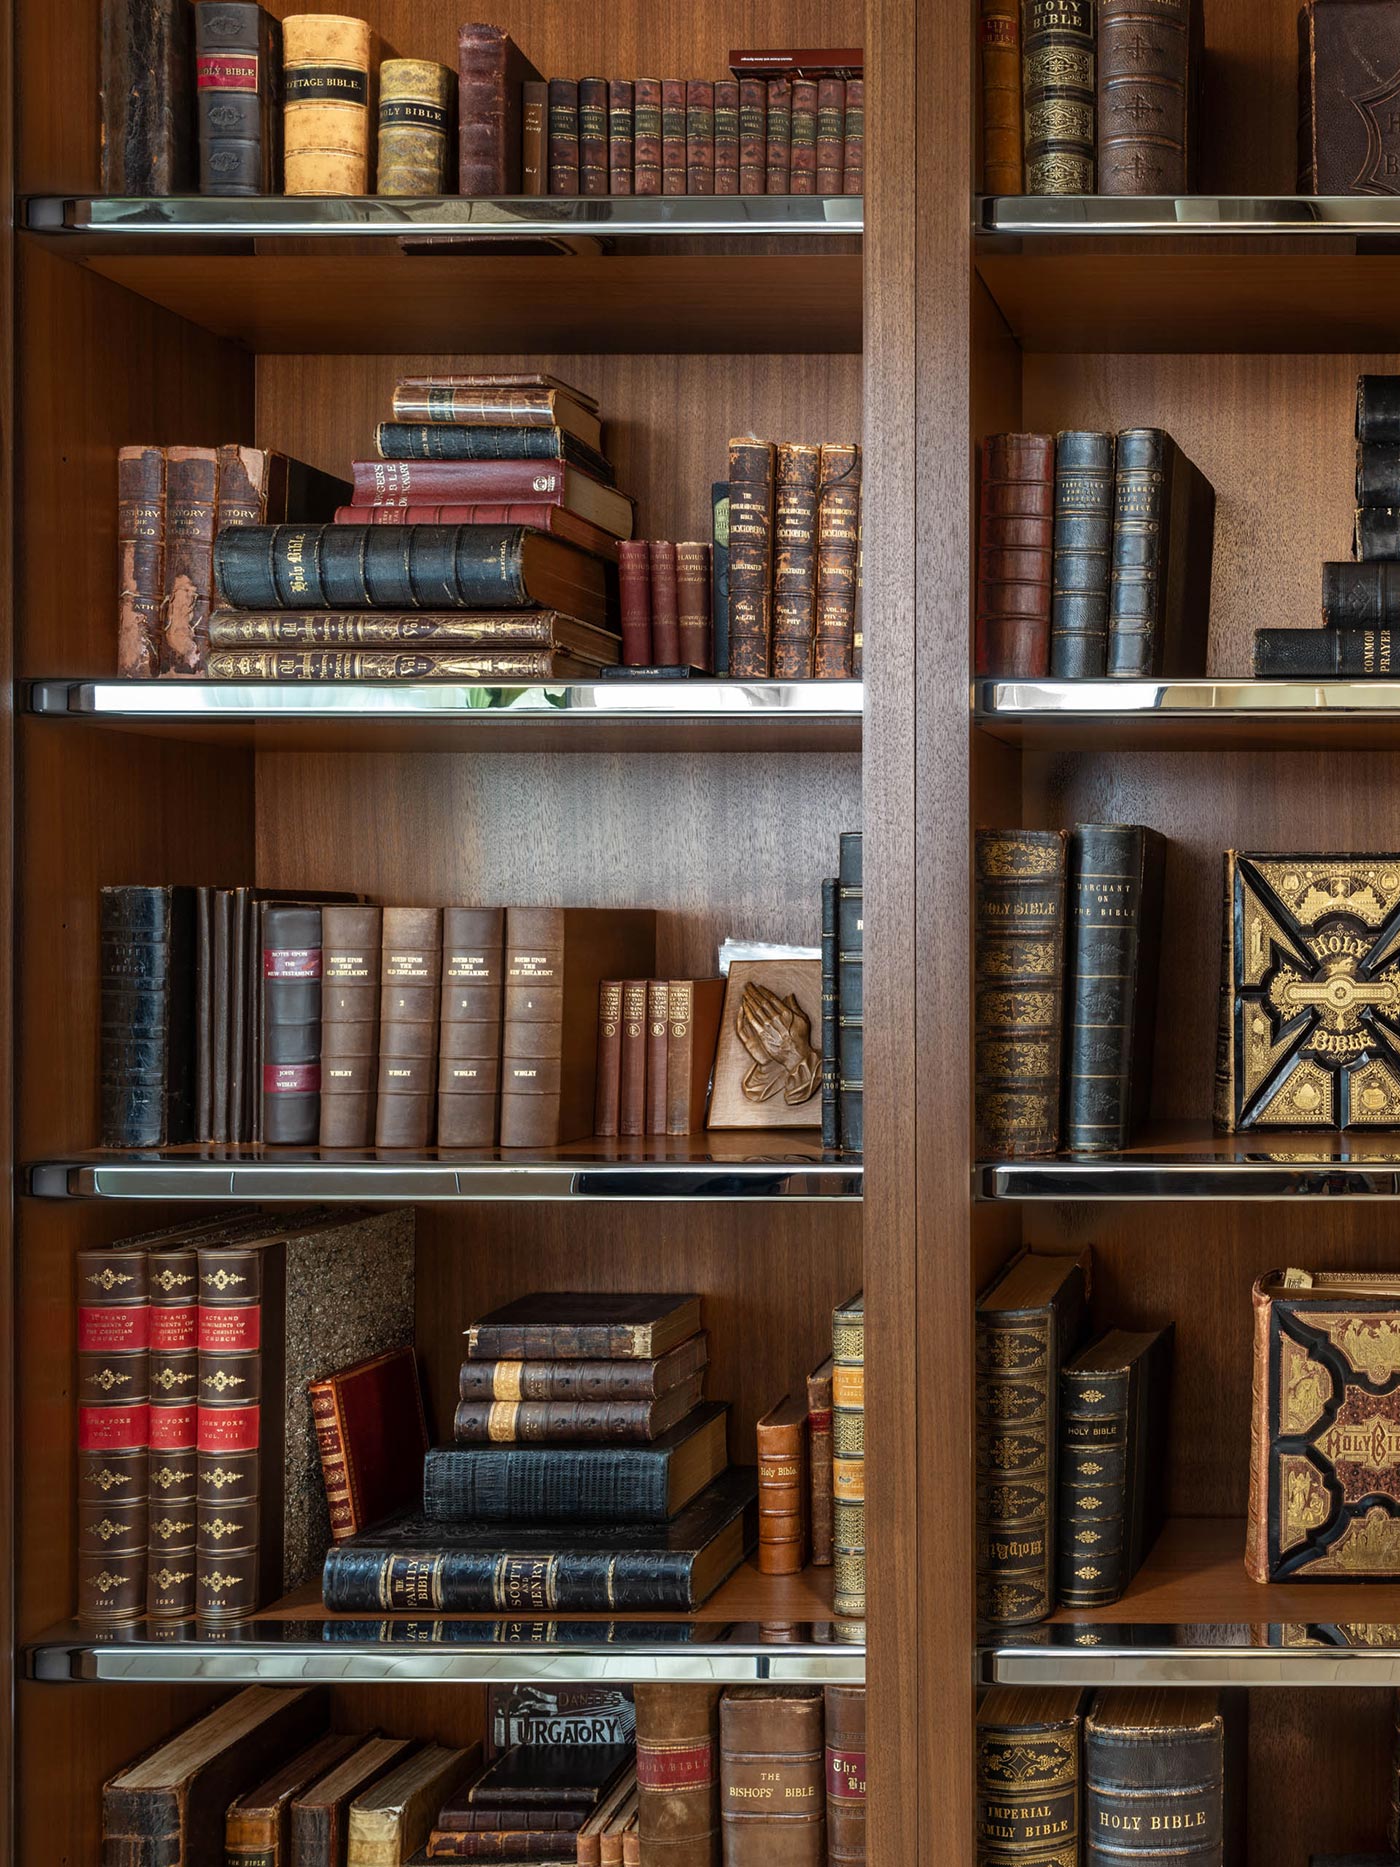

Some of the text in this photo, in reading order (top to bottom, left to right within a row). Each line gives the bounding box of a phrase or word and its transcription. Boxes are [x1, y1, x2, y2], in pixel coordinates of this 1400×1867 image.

[1034, 0, 1081, 14] HOLY
[1033, 13, 1082, 29] BIBLE
[226, 67, 255, 77] BIBLE
[405, 107, 442, 121] BIBLE
[374, 464, 384, 507] UNGER'S
[386, 464, 396, 507] BIBLE
[289, 567, 308, 593] Holy
[283, 622, 299, 638] Old
[1364, 630, 1374, 672] COMMON
[1380, 629, 1390, 672] PRAYER
[281, 659, 295, 674] Old
[1077, 883, 1131, 893] MARCHANT
[1014, 902, 1056, 916] BIBLE
[1101, 908, 1135, 917] BIBLE
[1306, 935, 1373, 959] HOLY
[1308, 1029, 1377, 1052] BIBLE
[1068, 1426, 1118, 1437] HOLY BIBLE
[1325, 1429, 1370, 1459] HOLY
[761, 1467, 777, 1478] Holy
[396, 1579, 404, 1592] THE
[406, 1558, 418, 1607] FAMILY
[417, 1564, 429, 1601] BIBLE
[511, 1562, 523, 1607] SCOTT
[522, 1576, 530, 1594] AND
[531, 1560, 545, 1608] HENRY
[670, 1759, 710, 1771] BIBLE
[832, 1758, 857, 1775] The
[760, 1773, 781, 1781] THE
[785, 1786, 815, 1798] BIBLE
[987, 1805, 1052, 1819] IMPERIAL
[1025, 1820, 1068, 1838] BIBLE
[1100, 1811, 1206, 1831] HOLY BIBLE
